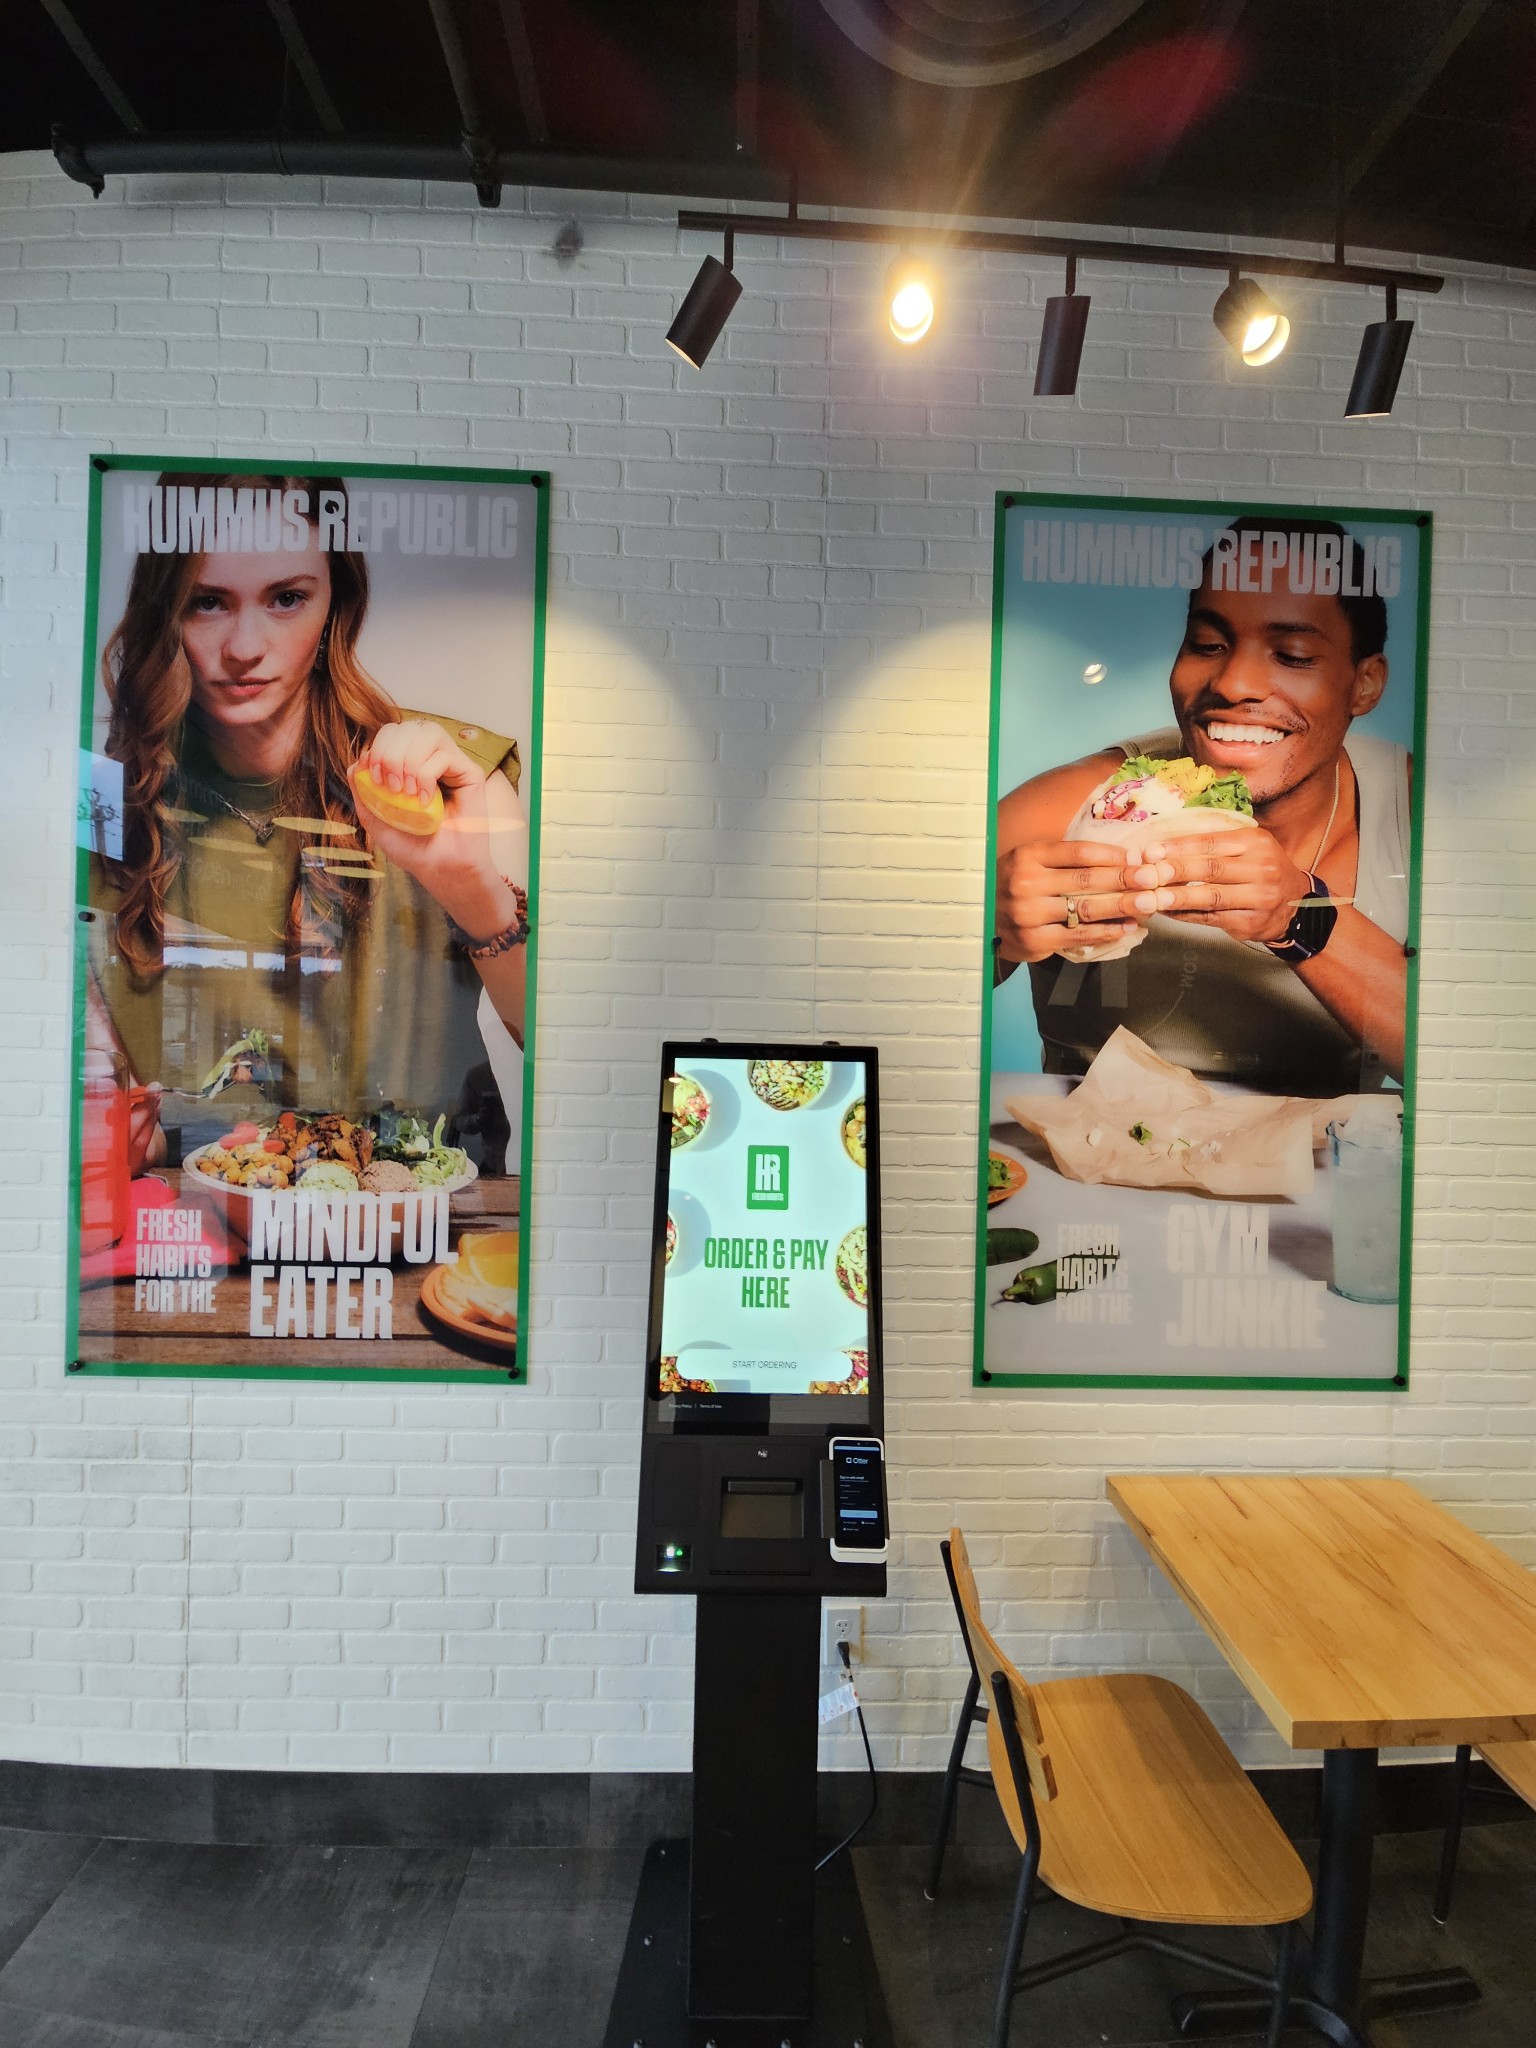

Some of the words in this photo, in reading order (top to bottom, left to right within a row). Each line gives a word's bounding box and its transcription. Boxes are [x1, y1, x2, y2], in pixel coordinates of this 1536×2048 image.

[122, 484, 310, 555] HUMMUS
[318, 490, 518, 559] REPUBLIC
[1023, 520, 1203, 590] HUMMUS
[1211, 529, 1401, 599] REPUBLIC
[136, 1207, 202, 1243] FRESH
[250, 1190, 459, 1264] MINDFUL
[1056, 1222, 1120, 1257] FRESH
[1165, 1203, 1270, 1275] GYM
[135, 1244, 212, 1278] HABITS
[704, 1237, 768, 1269] ORDER
[772, 1238, 786, 1270] &
[790, 1239, 829, 1271] PAY
[1056, 1256, 1129, 1291] HABITS
[134, 1280, 180, 1313] FOR
[181, 1281, 217, 1314] THE
[248, 1264, 394, 1341] EATER
[741, 1276, 791, 1309] HERE
[1055, 1291, 1095, 1325] FOR
[1098, 1292, 1134, 1326] THE
[1164, 1278, 1329, 1350] JUNKIE
[732, 1360, 756, 1369] START
[757, 1360, 798, 1370] ORDERING
